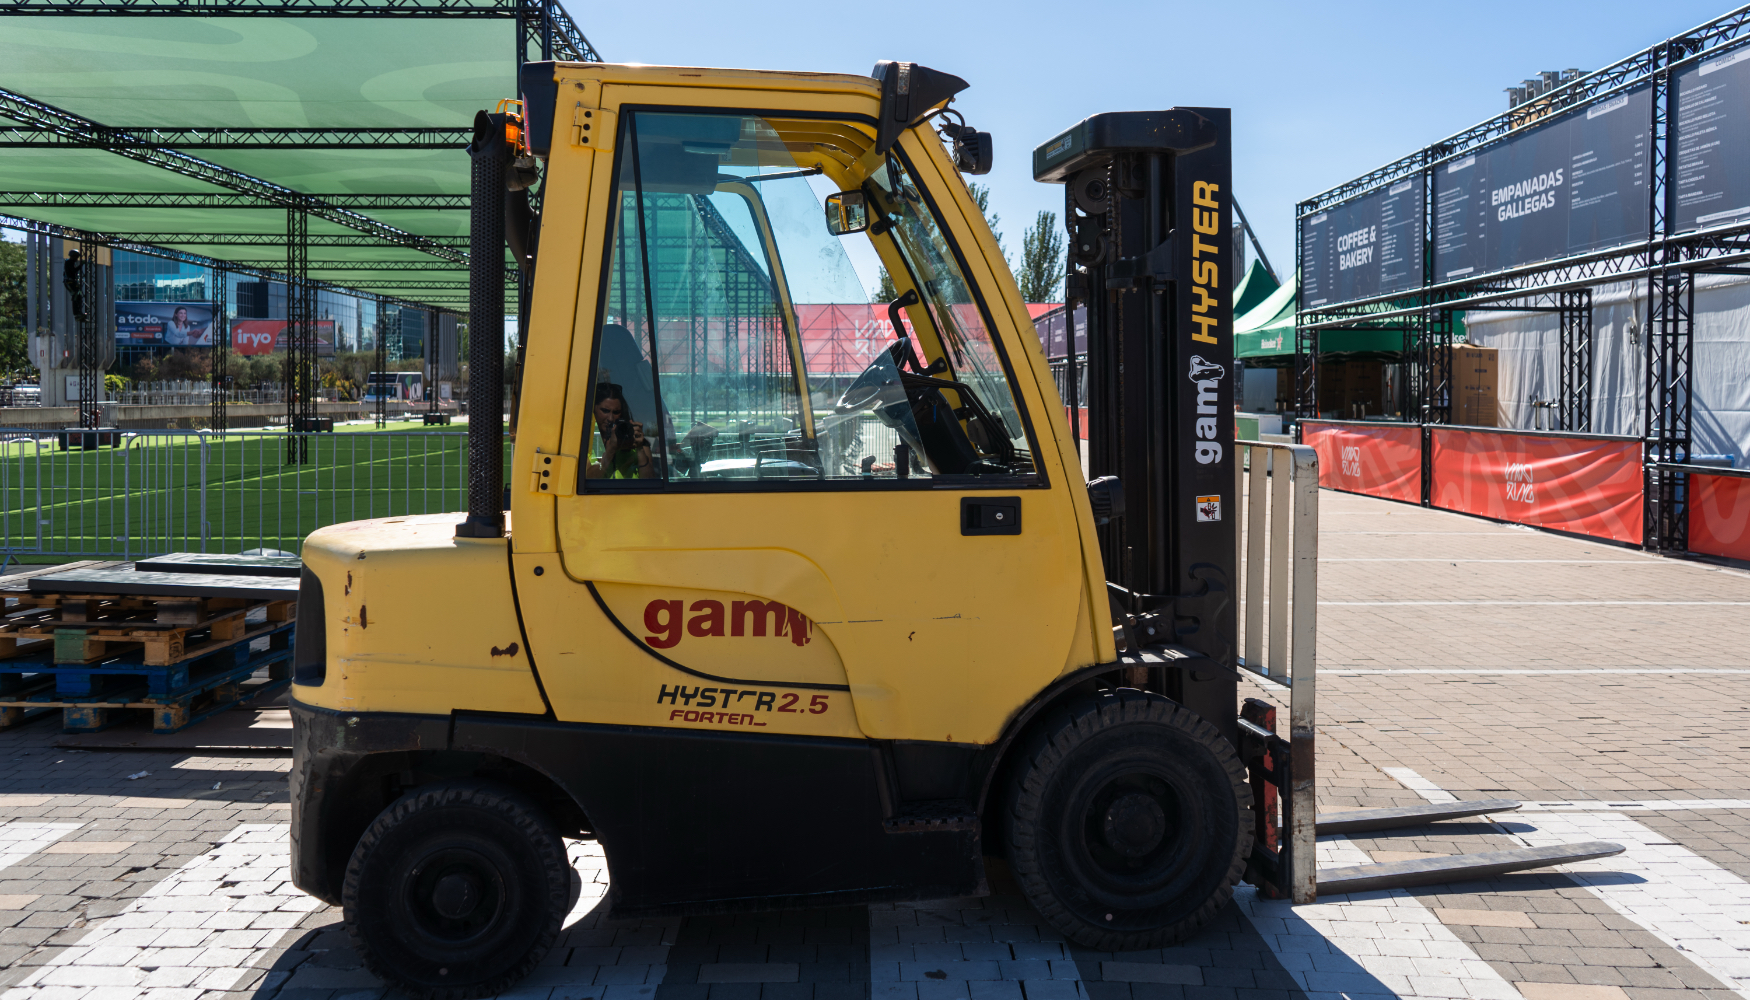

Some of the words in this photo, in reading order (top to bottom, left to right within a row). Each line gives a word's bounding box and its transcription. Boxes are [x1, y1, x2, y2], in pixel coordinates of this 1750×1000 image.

[1491, 168, 1564, 206] EMPANADAS
[1498, 190, 1556, 222] GALLEGAS
[1337, 227, 1368, 252] COFFEE
[1370, 225, 1376, 243] &
[1192, 180, 1220, 345] HYSTER
[1340, 245, 1374, 271] BAKERY
[128, 314, 162, 324] todo.
[237, 328, 272, 348] iryo
[1194, 379, 1223, 464] gam
[643, 599, 788, 649] gam
[777, 692, 830, 714] 2.5
